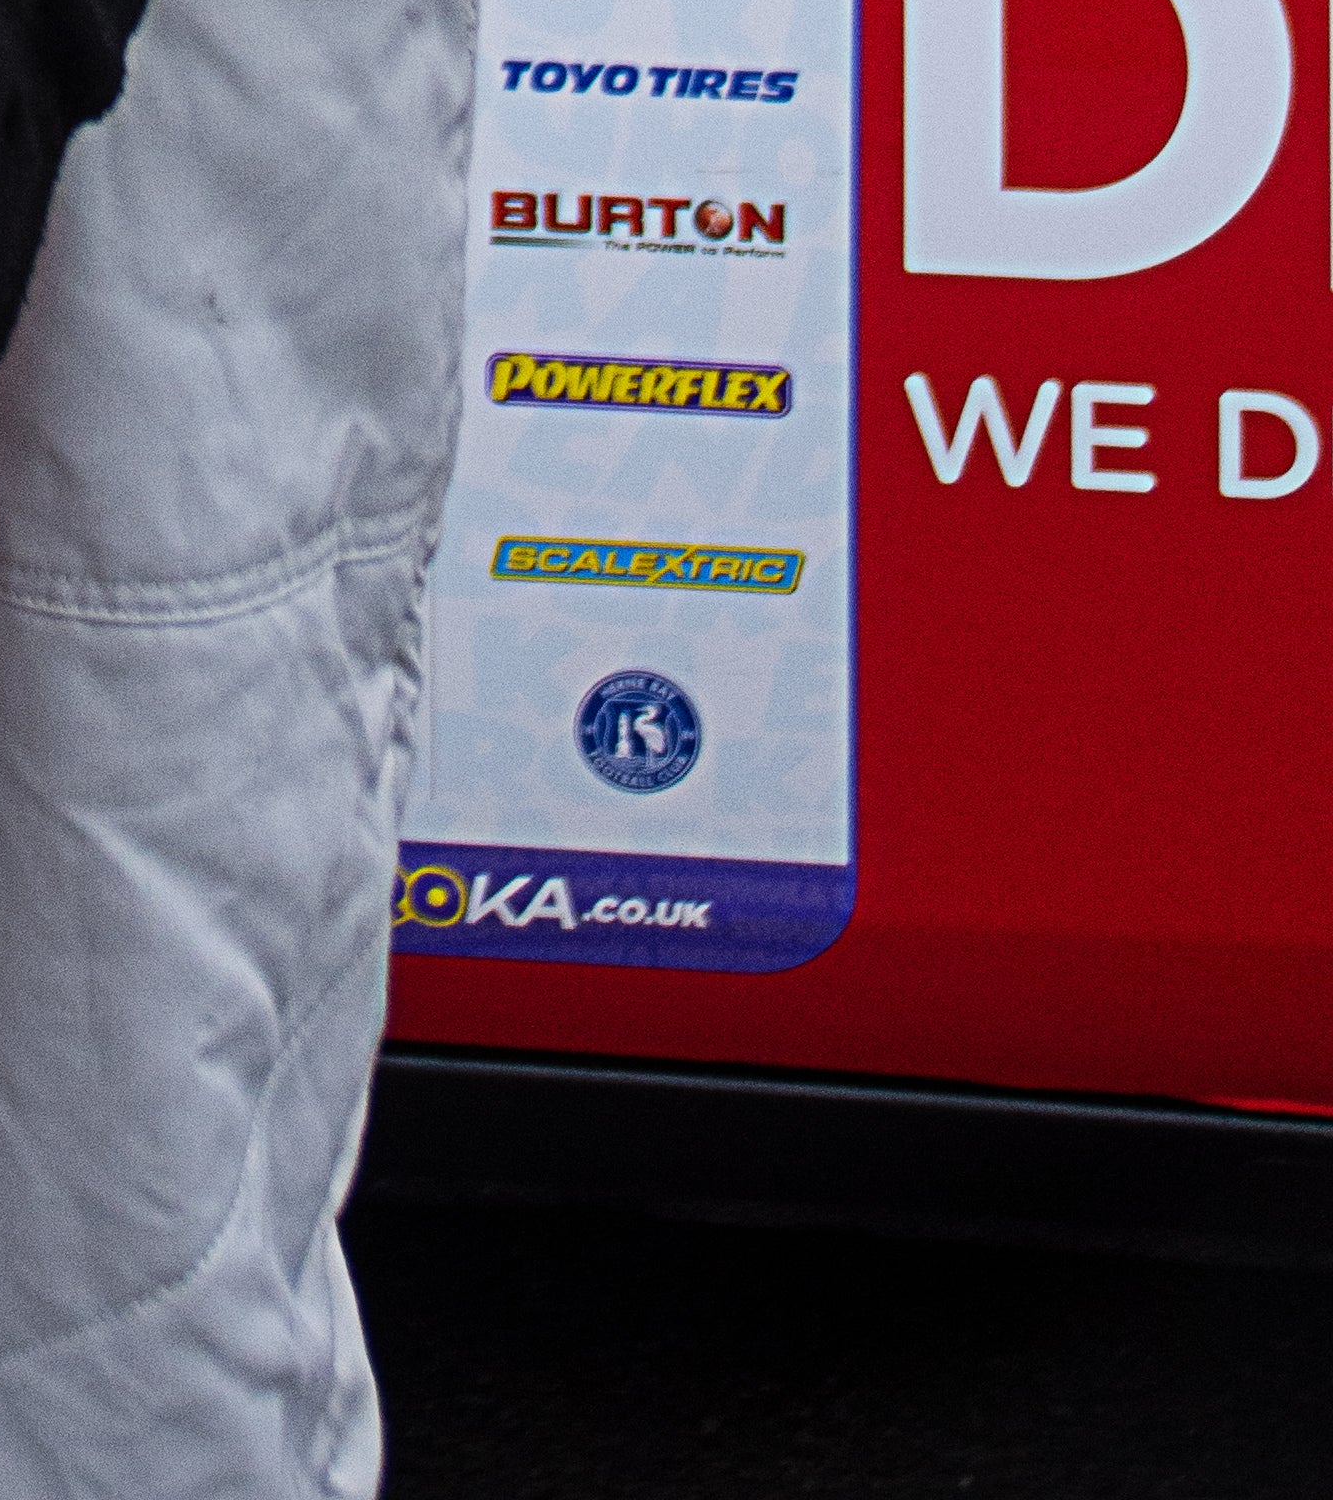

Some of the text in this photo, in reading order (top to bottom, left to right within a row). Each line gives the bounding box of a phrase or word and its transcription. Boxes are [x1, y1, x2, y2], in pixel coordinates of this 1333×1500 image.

[500, 59, 800, 104] TOYO TIRES
[490, 188, 787, 244] BURTON
[490, 352, 790, 412] POWERFLEX
[903, 370, 1323, 501] WE D
[504, 543, 789, 586] SCALEXTRIC
